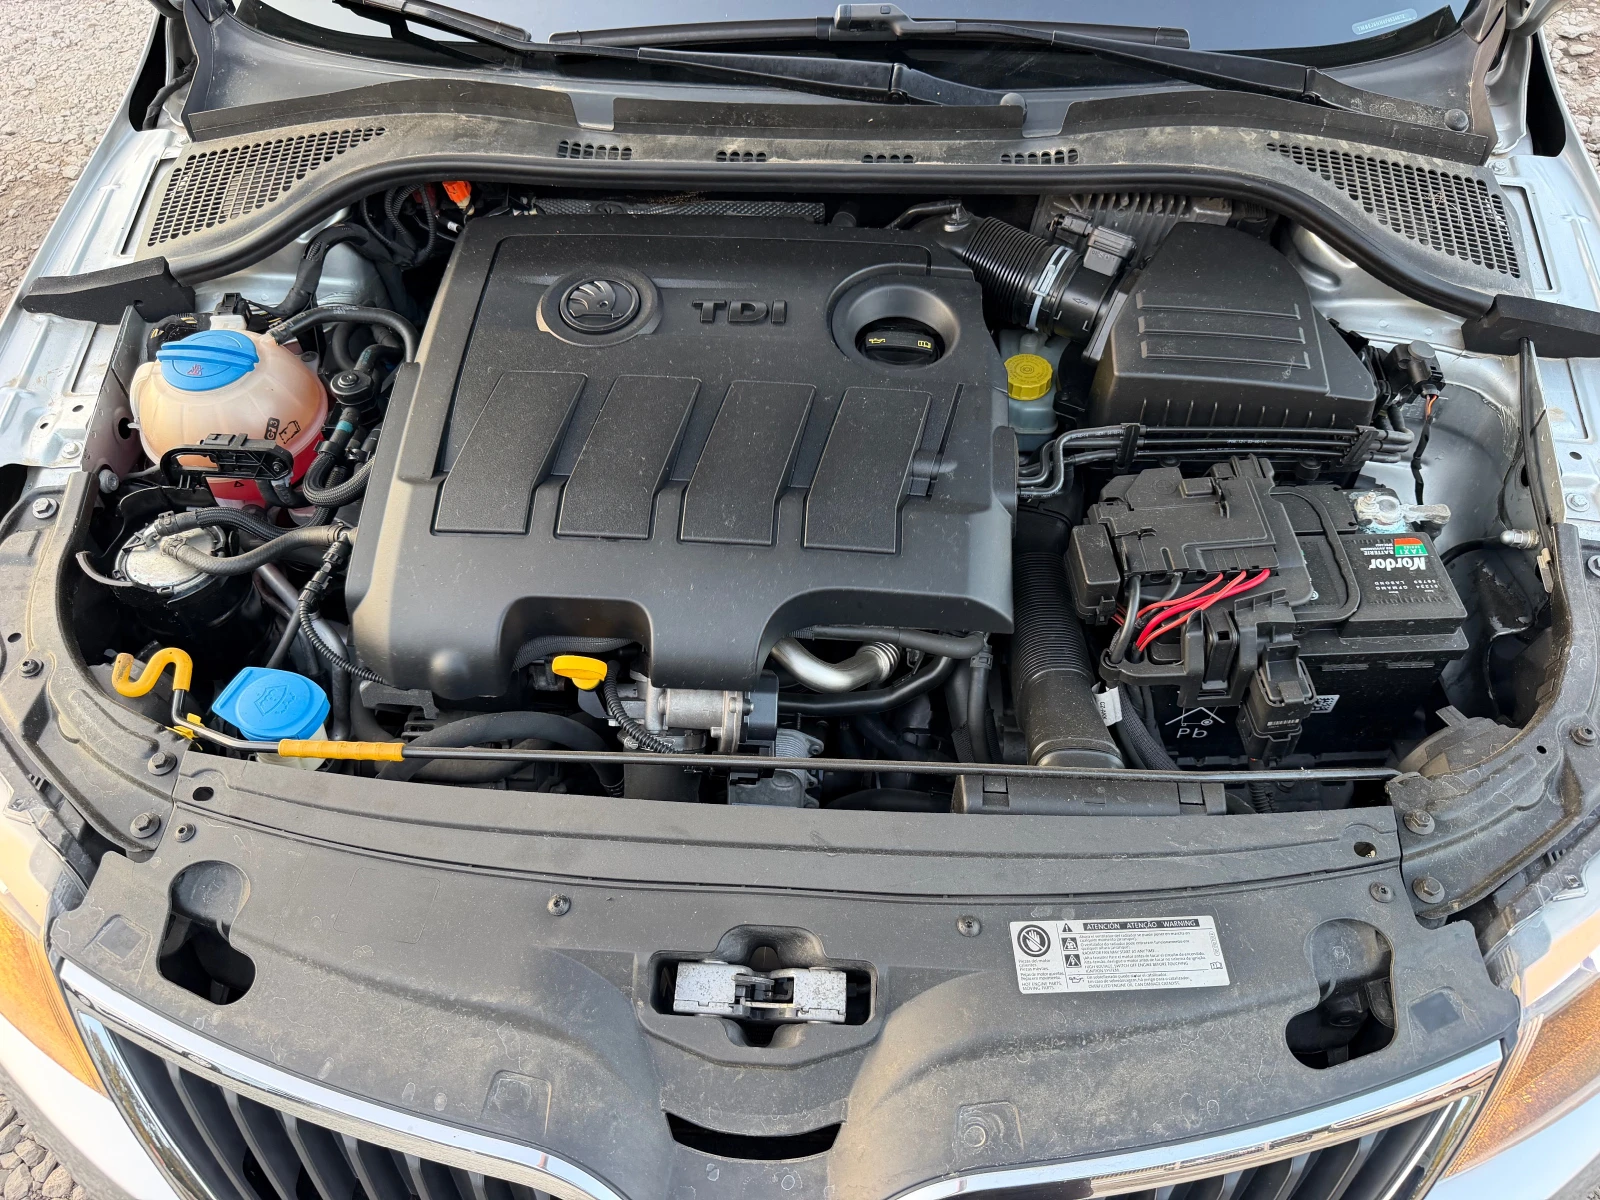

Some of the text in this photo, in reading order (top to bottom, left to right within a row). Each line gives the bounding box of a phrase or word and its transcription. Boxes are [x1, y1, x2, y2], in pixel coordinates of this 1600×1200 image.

[692, 299, 788, 325] TDI
[1368, 557, 1426, 571] Nordor
[1176, 728, 1208, 739] Pb
[1087, 919, 1196, 930] ATENCIÓN ATENÇÃO WARNING
